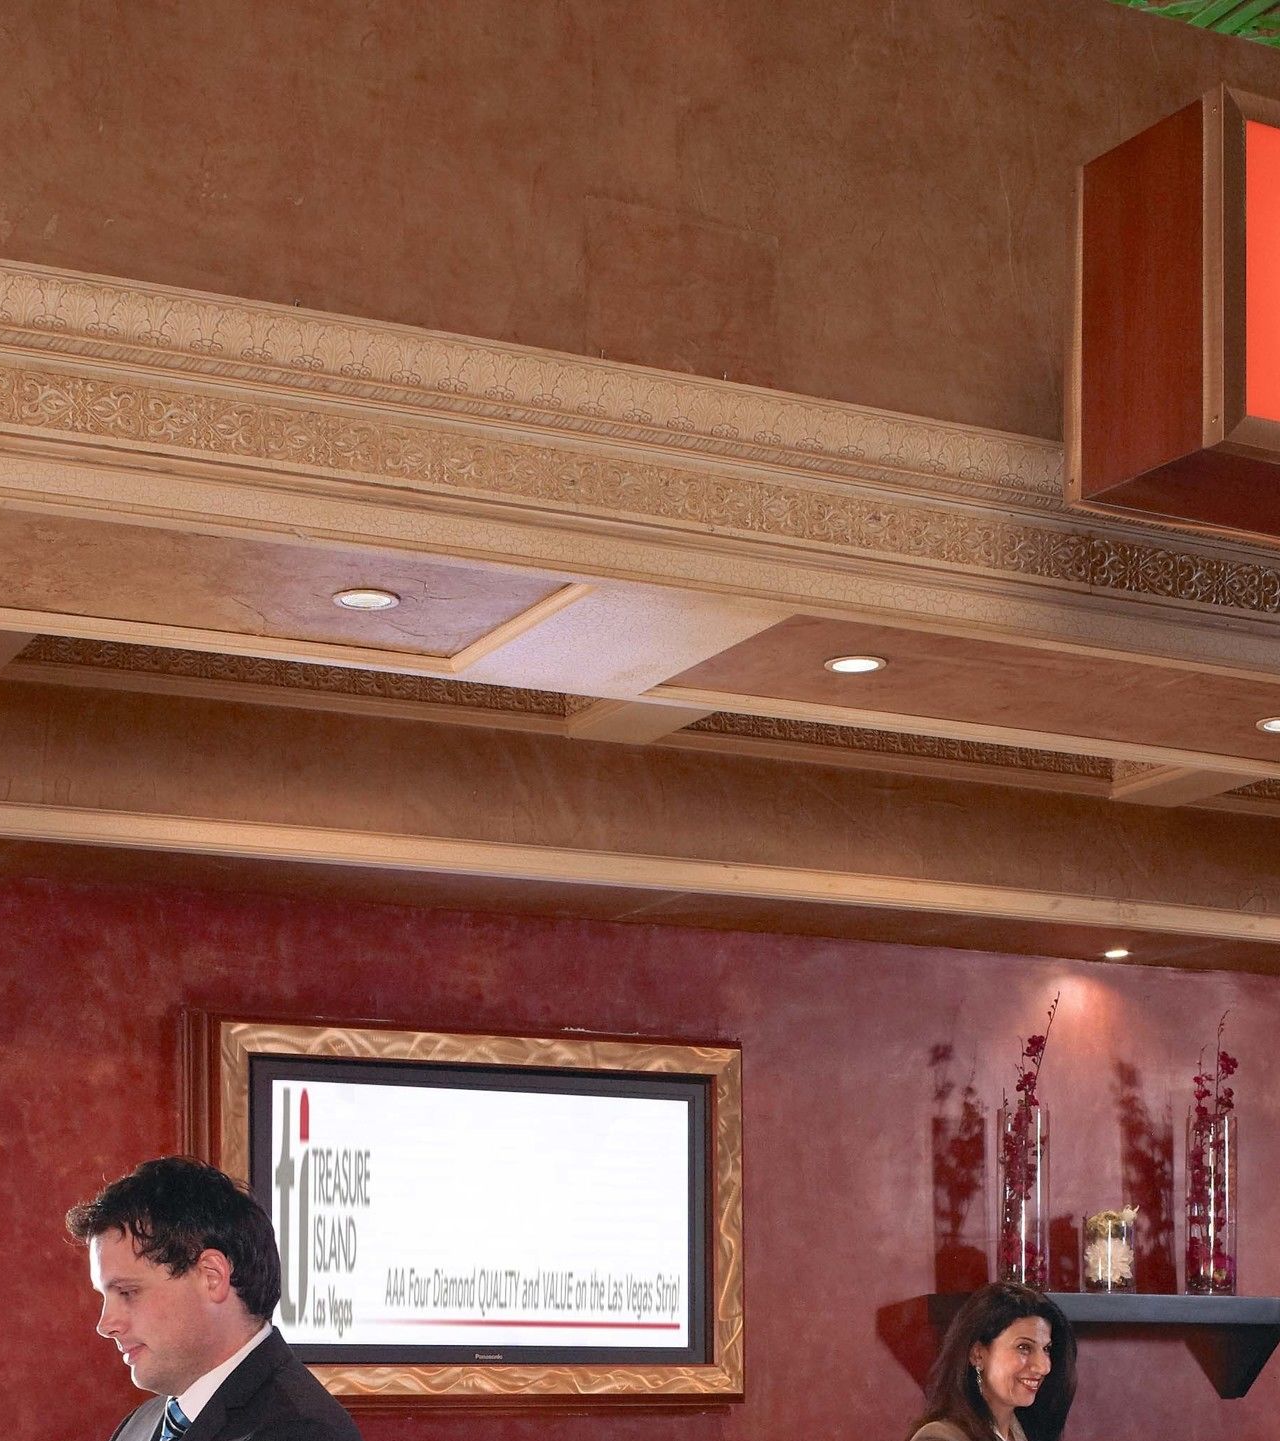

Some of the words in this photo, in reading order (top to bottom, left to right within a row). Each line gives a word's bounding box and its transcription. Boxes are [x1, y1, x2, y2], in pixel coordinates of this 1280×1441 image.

[312, 1149, 371, 1207] TREASURE
[313, 1215, 357, 1273] ISLAND
[312, 1287, 326, 1328] Las
[328, 1284, 353, 1338] Vegas
[385, 1267, 406, 1306] AAA
[408, 1267, 431, 1308] Four
[433, 1267, 476, 1309] Diamond
[478, 1268, 521, 1317] QUALITY
[522, 1267, 540, 1310] and
[542, 1270, 574, 1310] VALUE
[575, 1279, 587, 1310] on
[590, 1268, 605, 1311] the
[607, 1273, 623, 1311] Las
[626, 1273, 653, 1320] Vegas
[655, 1271, 681, 1319] Strip!
